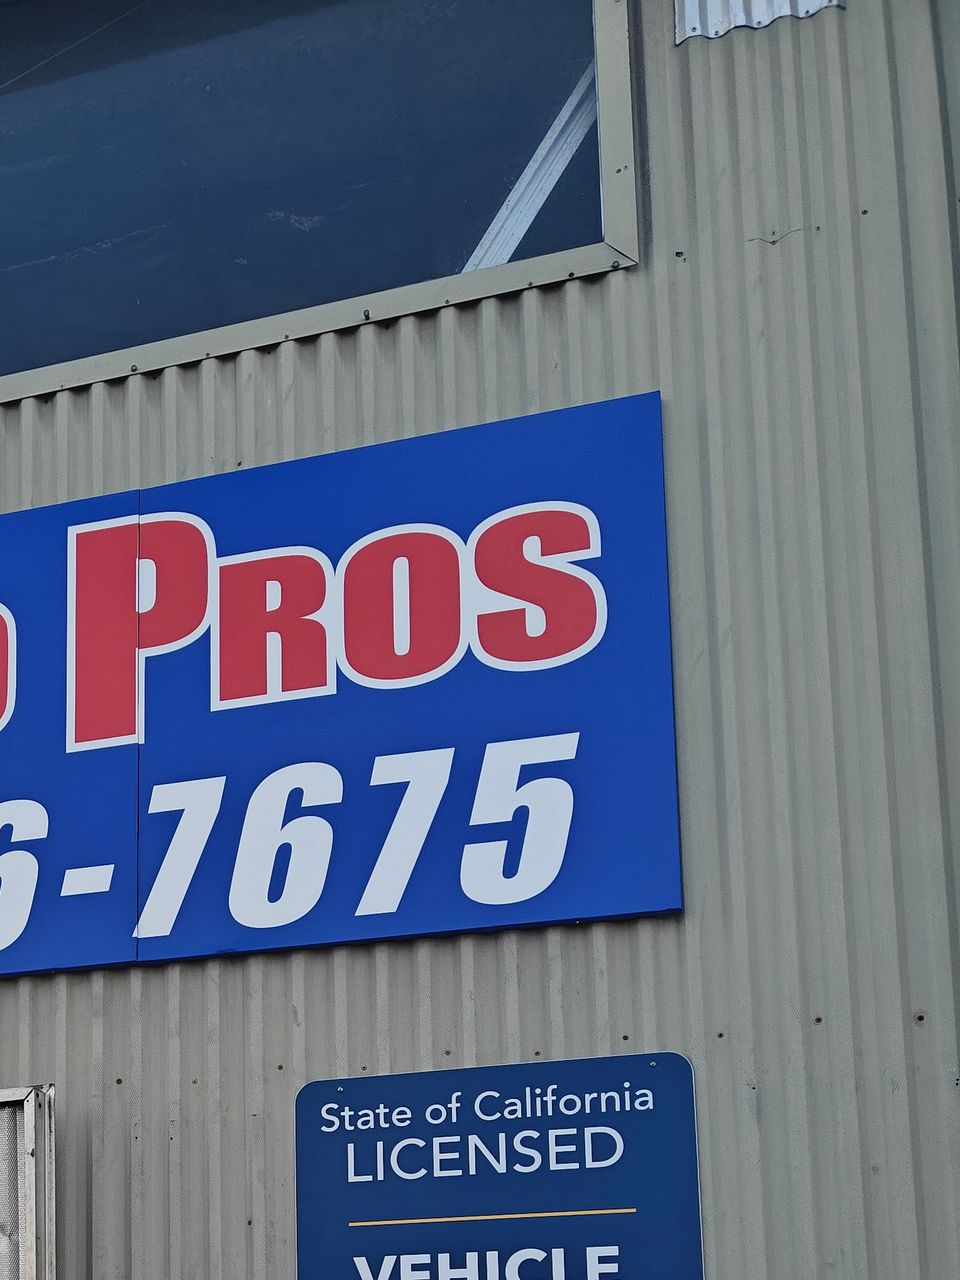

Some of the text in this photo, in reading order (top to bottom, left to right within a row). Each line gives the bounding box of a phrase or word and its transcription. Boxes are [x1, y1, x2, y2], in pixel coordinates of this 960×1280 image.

[66, 500, 608, 753] PROS
[320, 1081, 654, 1133] State of California
[346, 1125, 625, 1183] LICENSED
